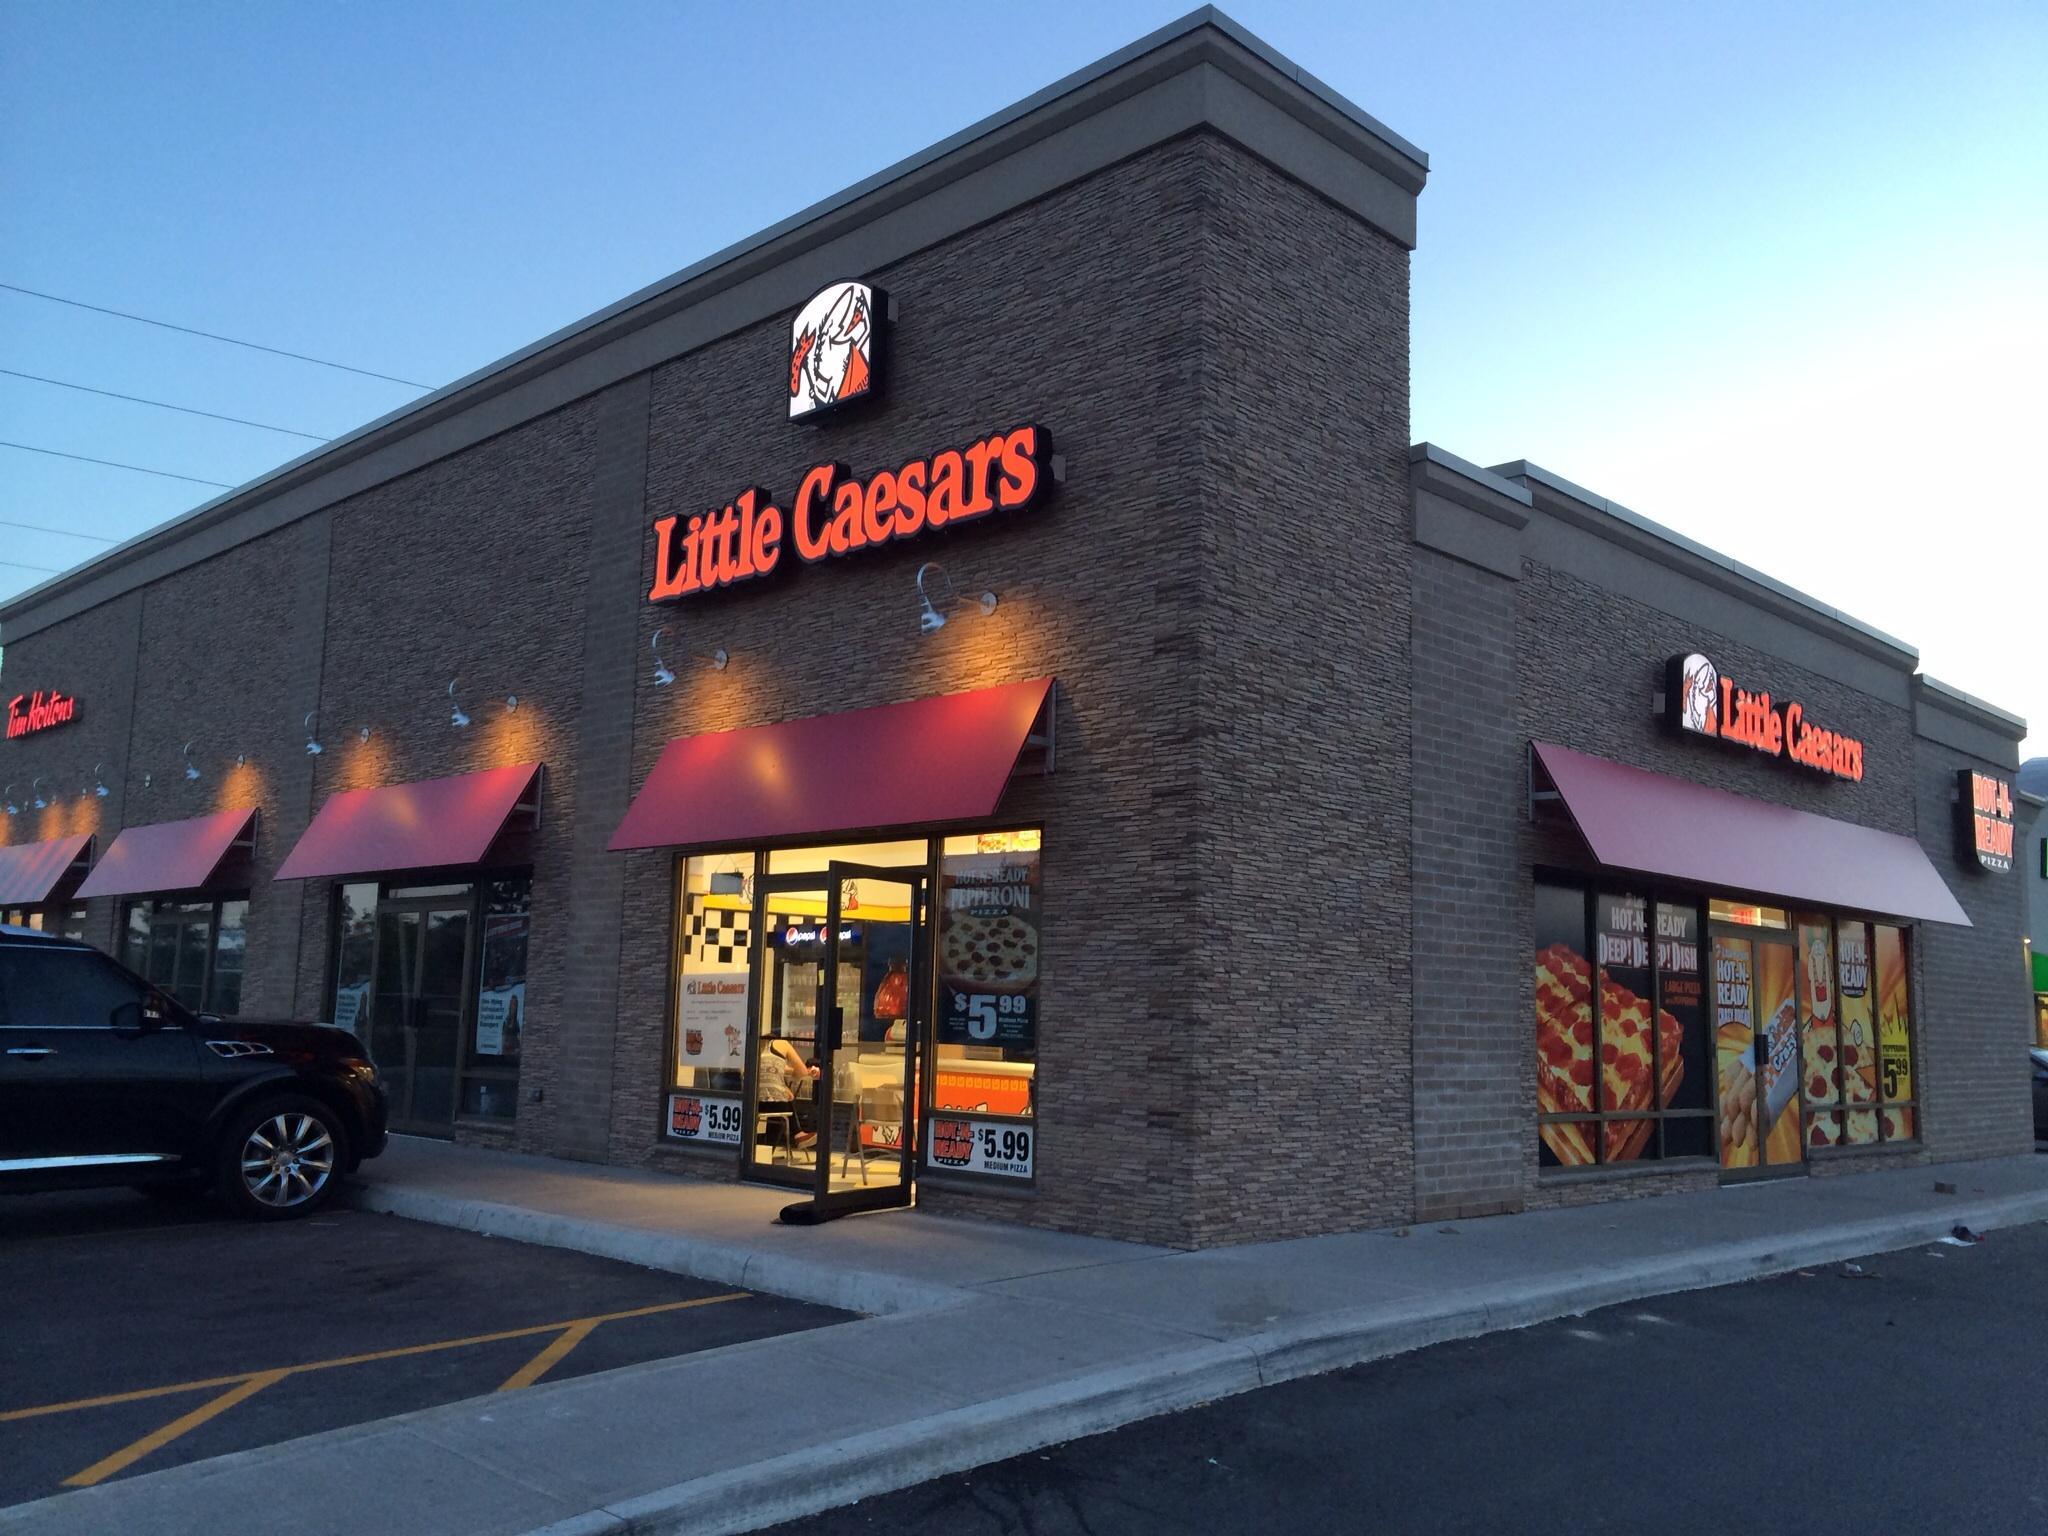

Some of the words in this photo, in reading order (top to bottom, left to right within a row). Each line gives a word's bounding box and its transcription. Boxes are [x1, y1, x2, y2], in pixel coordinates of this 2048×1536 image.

[647, 488, 783, 601] Little
[793, 426, 1036, 561] Caesars
[7, 694, 27, 739] Tim
[28, 690, 74, 731] Hortons
[1719, 675, 1782, 756] Little
[1786, 700, 1863, 781] Caesars
[1974, 814, 2014, 858] READY
[1981, 855, 2009, 870] PIZZA
[950, 885, 1030, 912] PEPPERONI
[969, 908, 1008, 916] PIZZA
[1672, 941, 1697, 972] DISH
[1717, 982, 1749, 1007] READY
[705, 1104, 741, 1131] $5.99
[934, 1139, 974, 1160] READY
[978, 1128, 1029, 1162] $5.99
[984, 1160, 1008, 1171] MEDIUM
[1010, 1162, 1028, 1173] PIZZA
